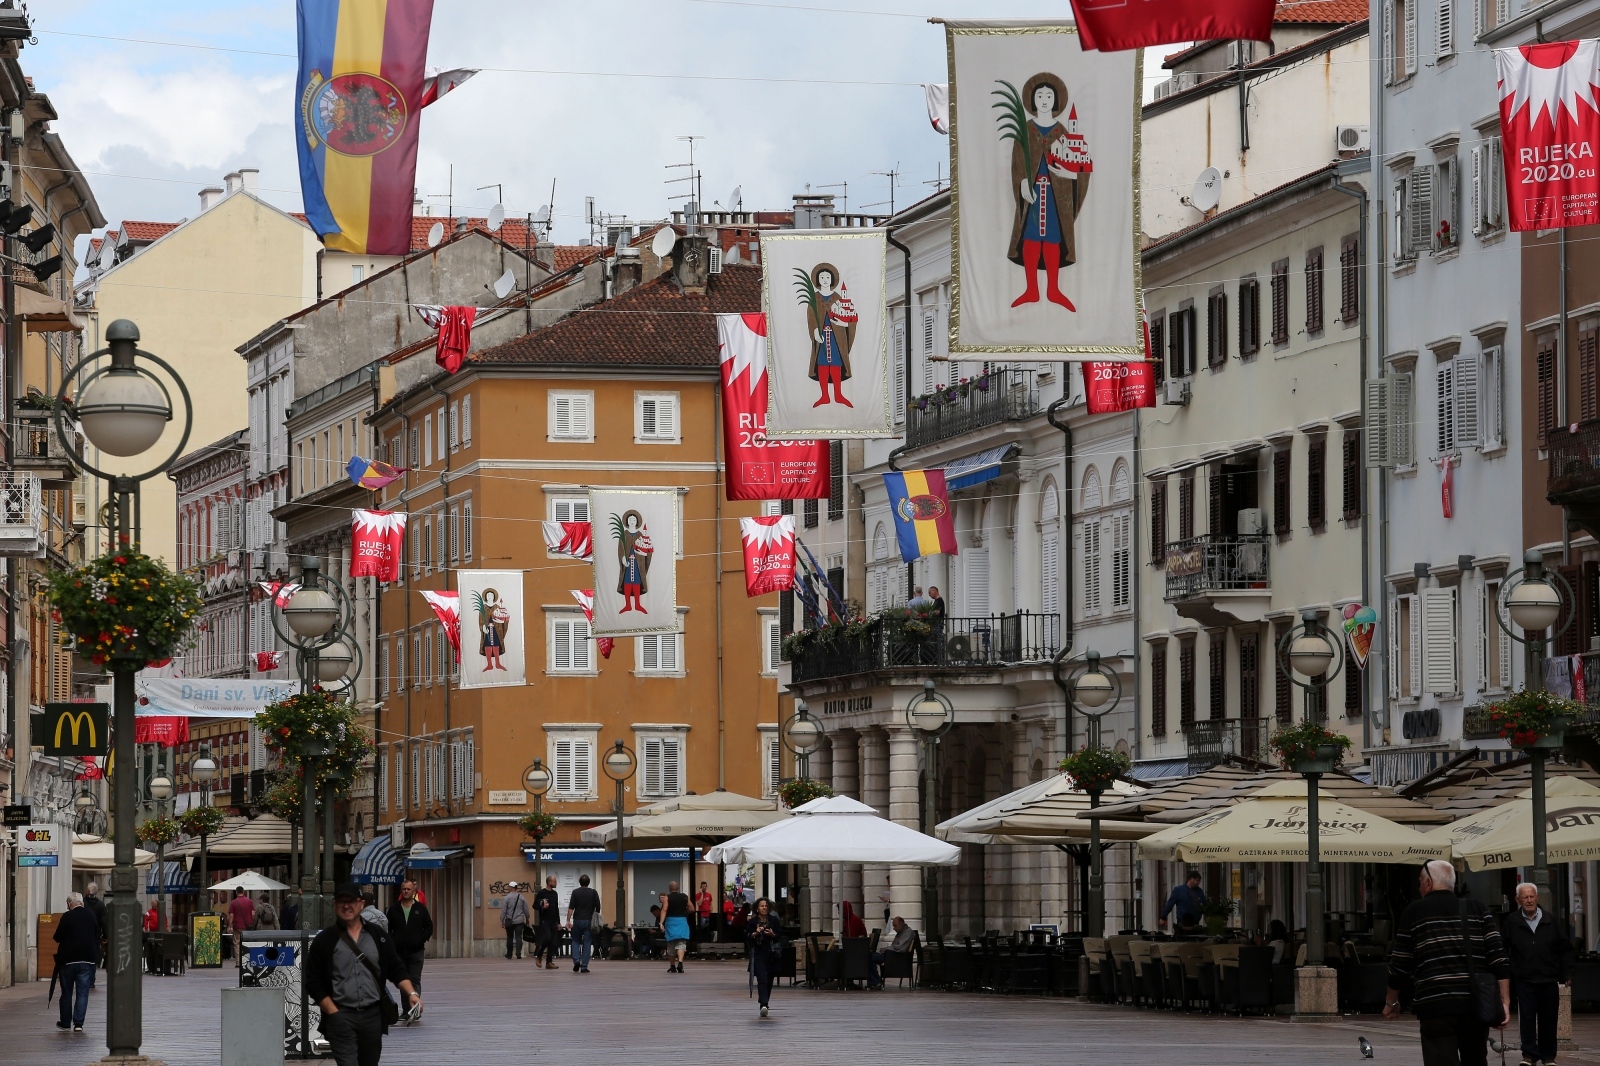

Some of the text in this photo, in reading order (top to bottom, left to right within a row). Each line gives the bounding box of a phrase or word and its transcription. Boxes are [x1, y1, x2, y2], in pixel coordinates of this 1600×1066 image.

[1520, 142, 1593, 164] RIJEKA
[1521, 163, 1595, 184] 2020.eu
[1562, 193, 1597, 201] EUROPEAN
[1564, 209, 1592, 217] CULTURE
[1094, 367, 1143, 380] 2020.eu
[739, 413, 767, 429] RIJ
[753, 553, 790, 565] RIJEKA
[181, 685, 219, 701] Dani
[224, 689, 246, 701] sv.
[1190, 846, 1230, 854] Jamnica
[1401, 846, 1443, 855] Jamnica
[1548, 850, 1584, 858] ATURAL
[1482, 852, 1512, 866] Jana
